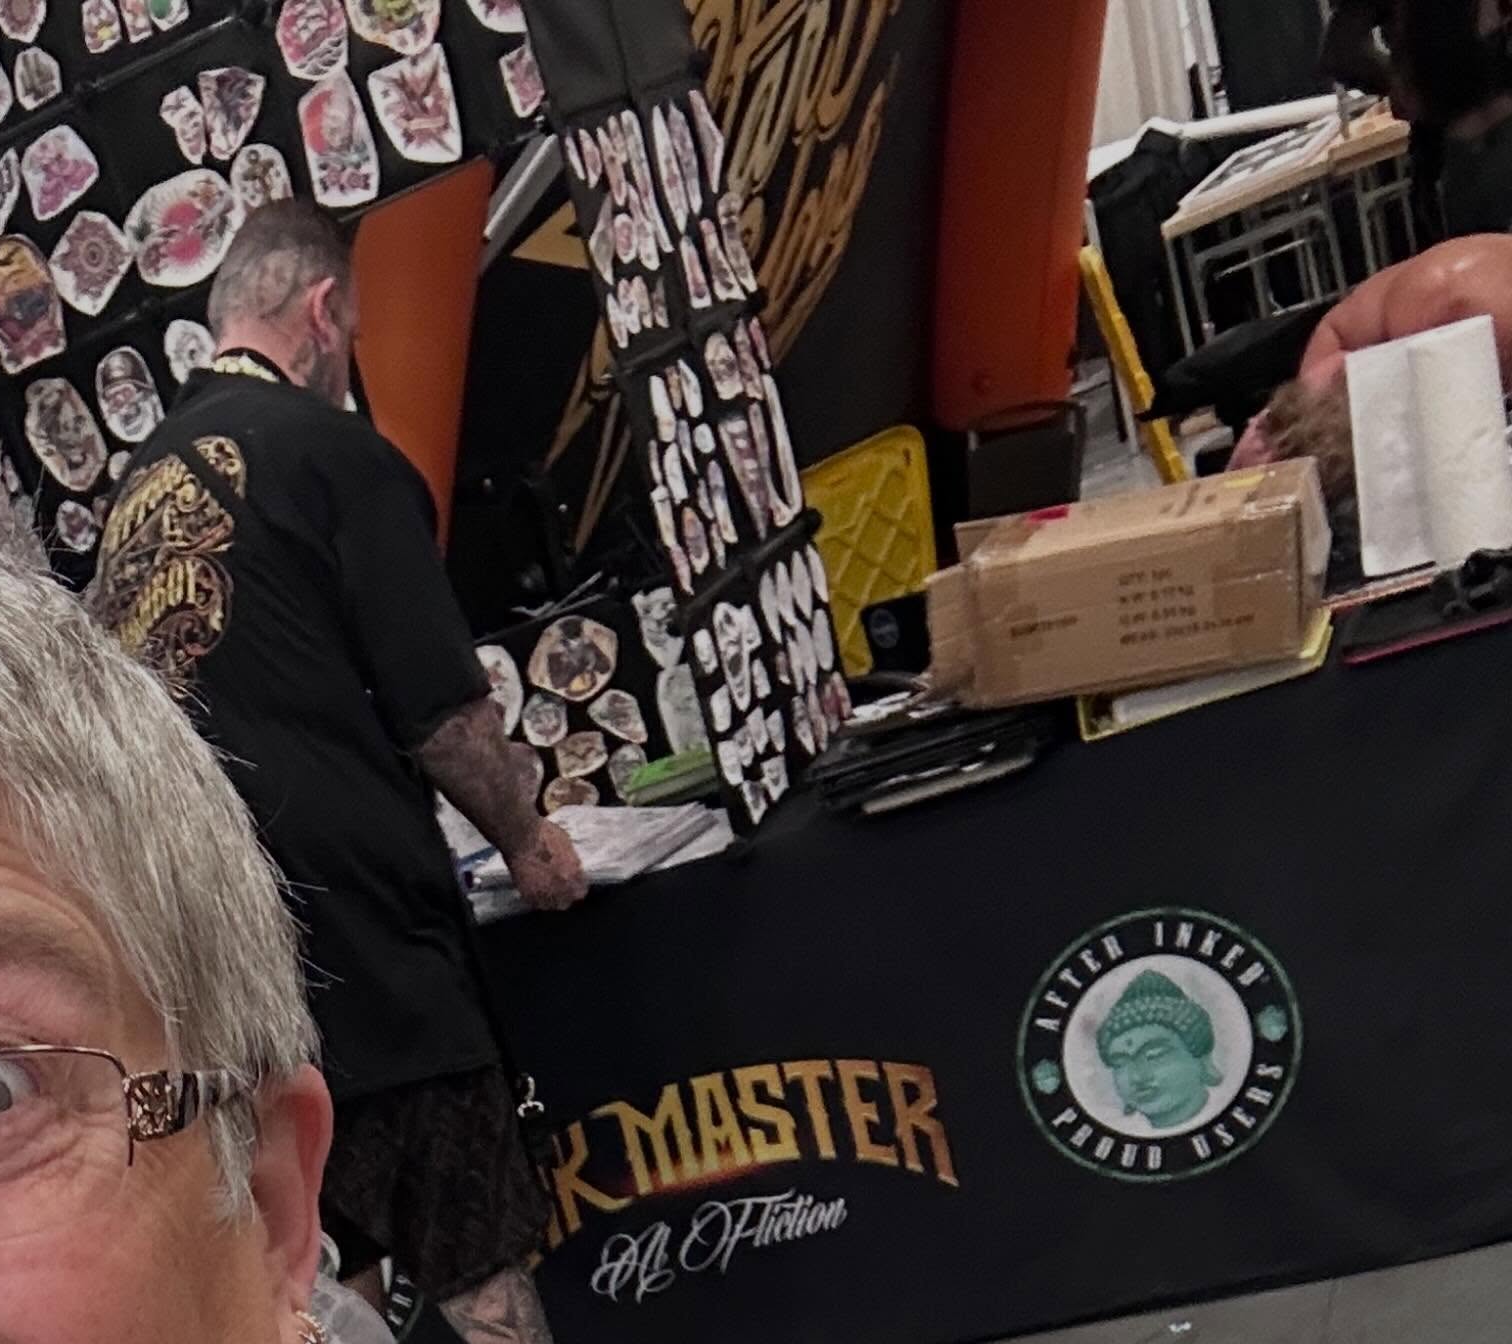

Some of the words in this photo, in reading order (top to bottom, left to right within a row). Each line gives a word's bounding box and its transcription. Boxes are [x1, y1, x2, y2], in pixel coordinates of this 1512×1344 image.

[1034, 934, 1124, 1033] AFTER
[1152, 921, 1266, 987] INKED
[589, 1057, 961, 1197] MASTER
[1051, 1106, 1163, 1171] PROUD
[1190, 1062, 1285, 1160] USERS
